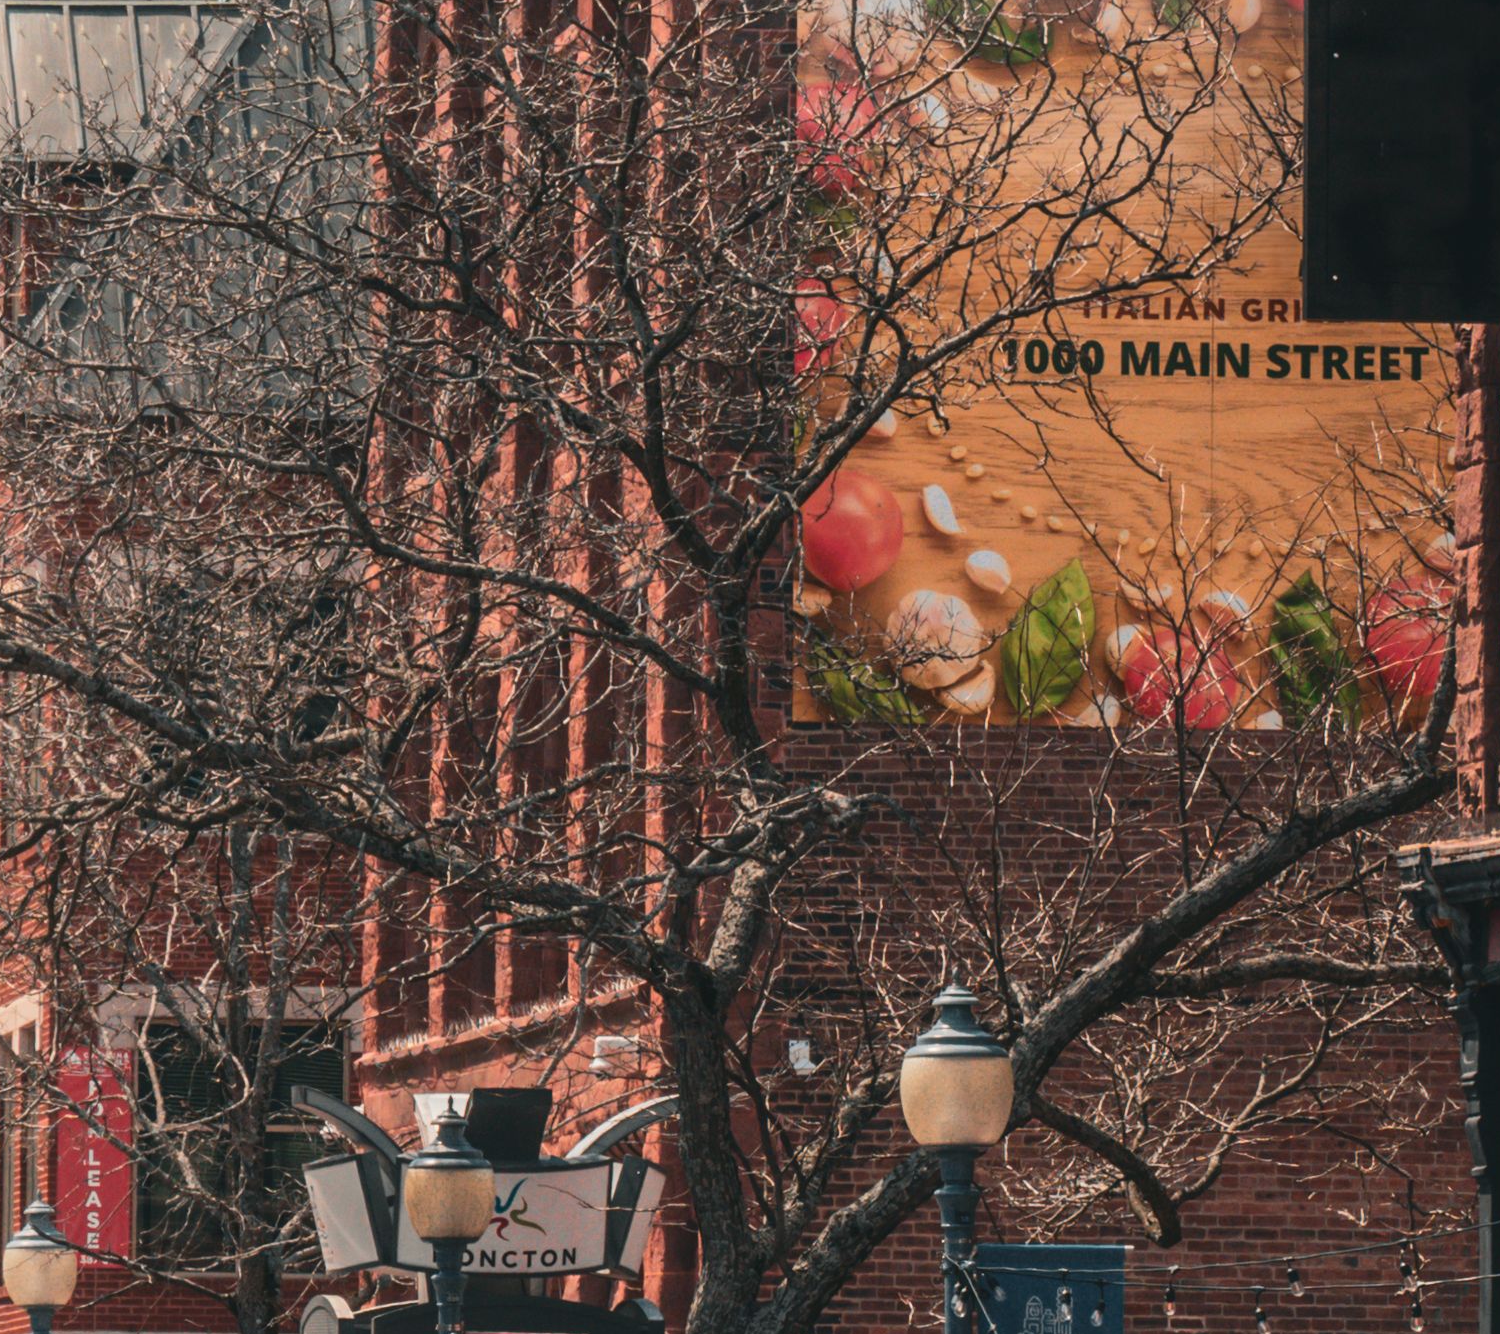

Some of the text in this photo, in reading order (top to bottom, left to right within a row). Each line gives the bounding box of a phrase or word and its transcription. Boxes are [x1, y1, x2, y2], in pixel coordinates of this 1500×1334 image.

[1083, 297, 1303, 323] ITALIAN GRI
[1001, 338, 1430, 382] 1000 MAIN STREET
[85, 1148, 102, 1250] LEASE
[432, 1247, 578, 1269] ONCTON
